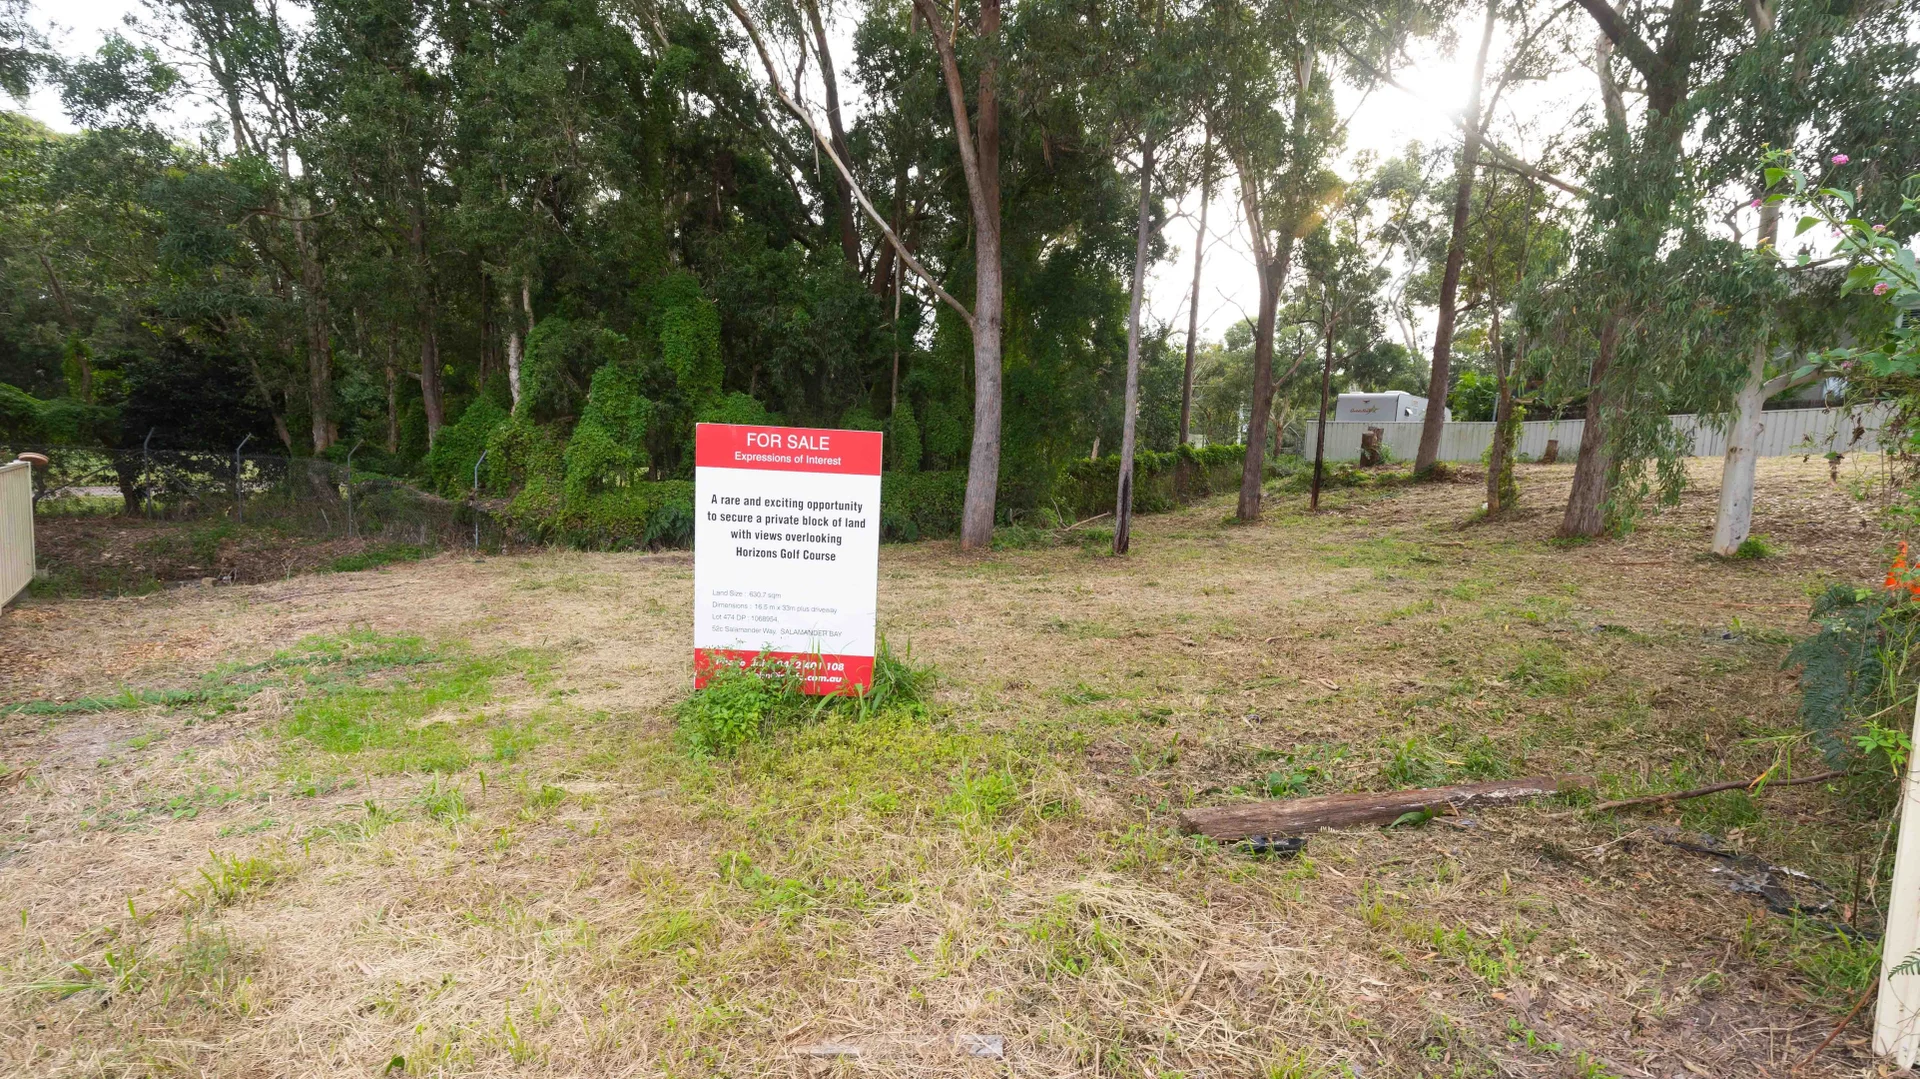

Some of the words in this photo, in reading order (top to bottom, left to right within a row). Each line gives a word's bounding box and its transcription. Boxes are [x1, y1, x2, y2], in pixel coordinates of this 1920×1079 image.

[747, 433, 781, 448] FOR
[788, 435, 829, 450] SALE
[735, 452, 791, 463] Expressions
[794, 454, 802, 463] of
[807, 456, 841, 465] Interest
[711, 494, 718, 504] A
[721, 496, 740, 505] rare
[744, 497, 761, 506] and
[765, 498, 803, 510] exciting
[808, 501, 863, 513] opportunity
[708, 511, 717, 521] to
[720, 513, 753, 523] secure
[757, 515, 762, 523] a
[766, 514, 799, 526] private
[803, 516, 829, 527] block
[832, 517, 842, 527] of
[846, 518, 865, 528] land
[731, 530, 751, 539] with
[755, 531, 782, 541] views
[786, 532, 842, 546] overlooking
[737, 547, 777, 558] Horizons
[781, 549, 800, 559] Golf
[803, 550, 836, 561] Course
[712, 601, 748, 609] Dimensions
[797, 605, 810, 613] plus
[811, 606, 837, 614] driveway
[780, 628, 828, 637] SALAMANDER
[827, 663, 845, 671] 108
